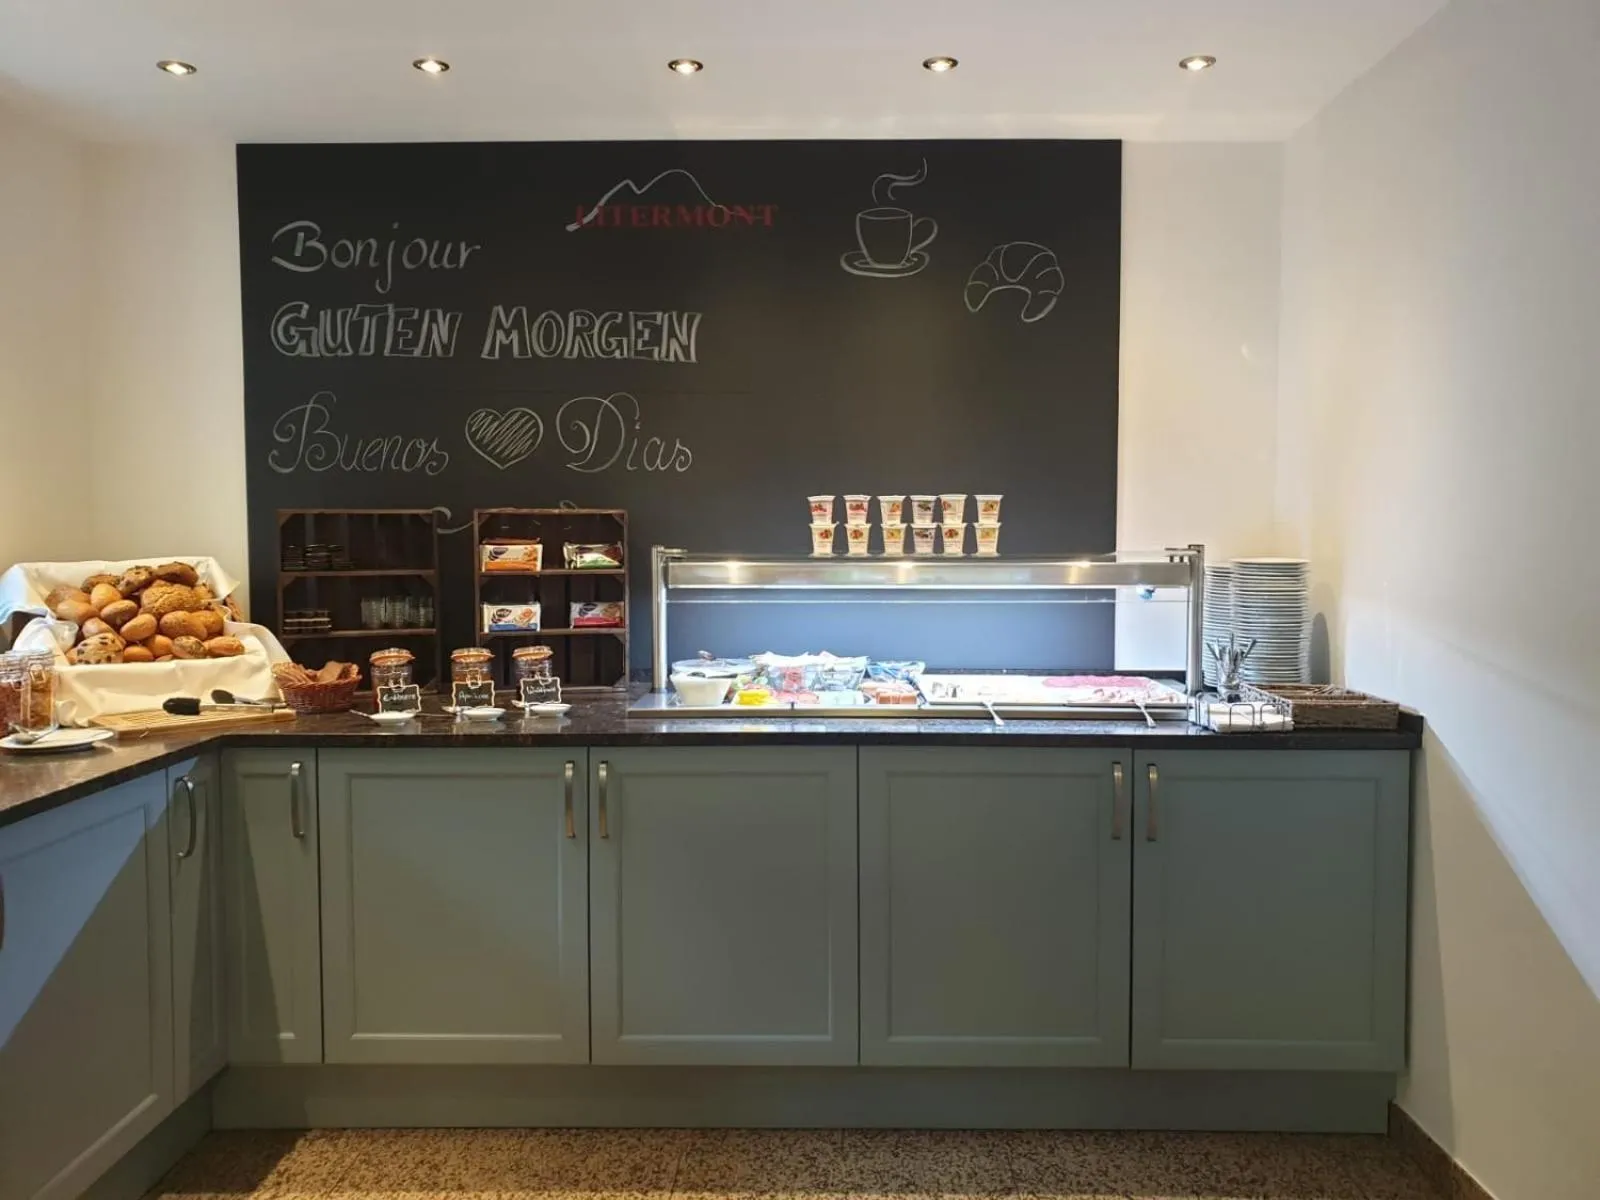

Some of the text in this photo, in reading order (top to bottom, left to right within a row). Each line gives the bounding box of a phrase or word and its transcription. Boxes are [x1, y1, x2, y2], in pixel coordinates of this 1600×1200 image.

[575, 204, 779, 228] LITERMONT
[271, 220, 481, 294] Bonjour
[270, 301, 703, 364] GUTEN MORGEN
[267, 391, 693, 476] Buenos Dias
